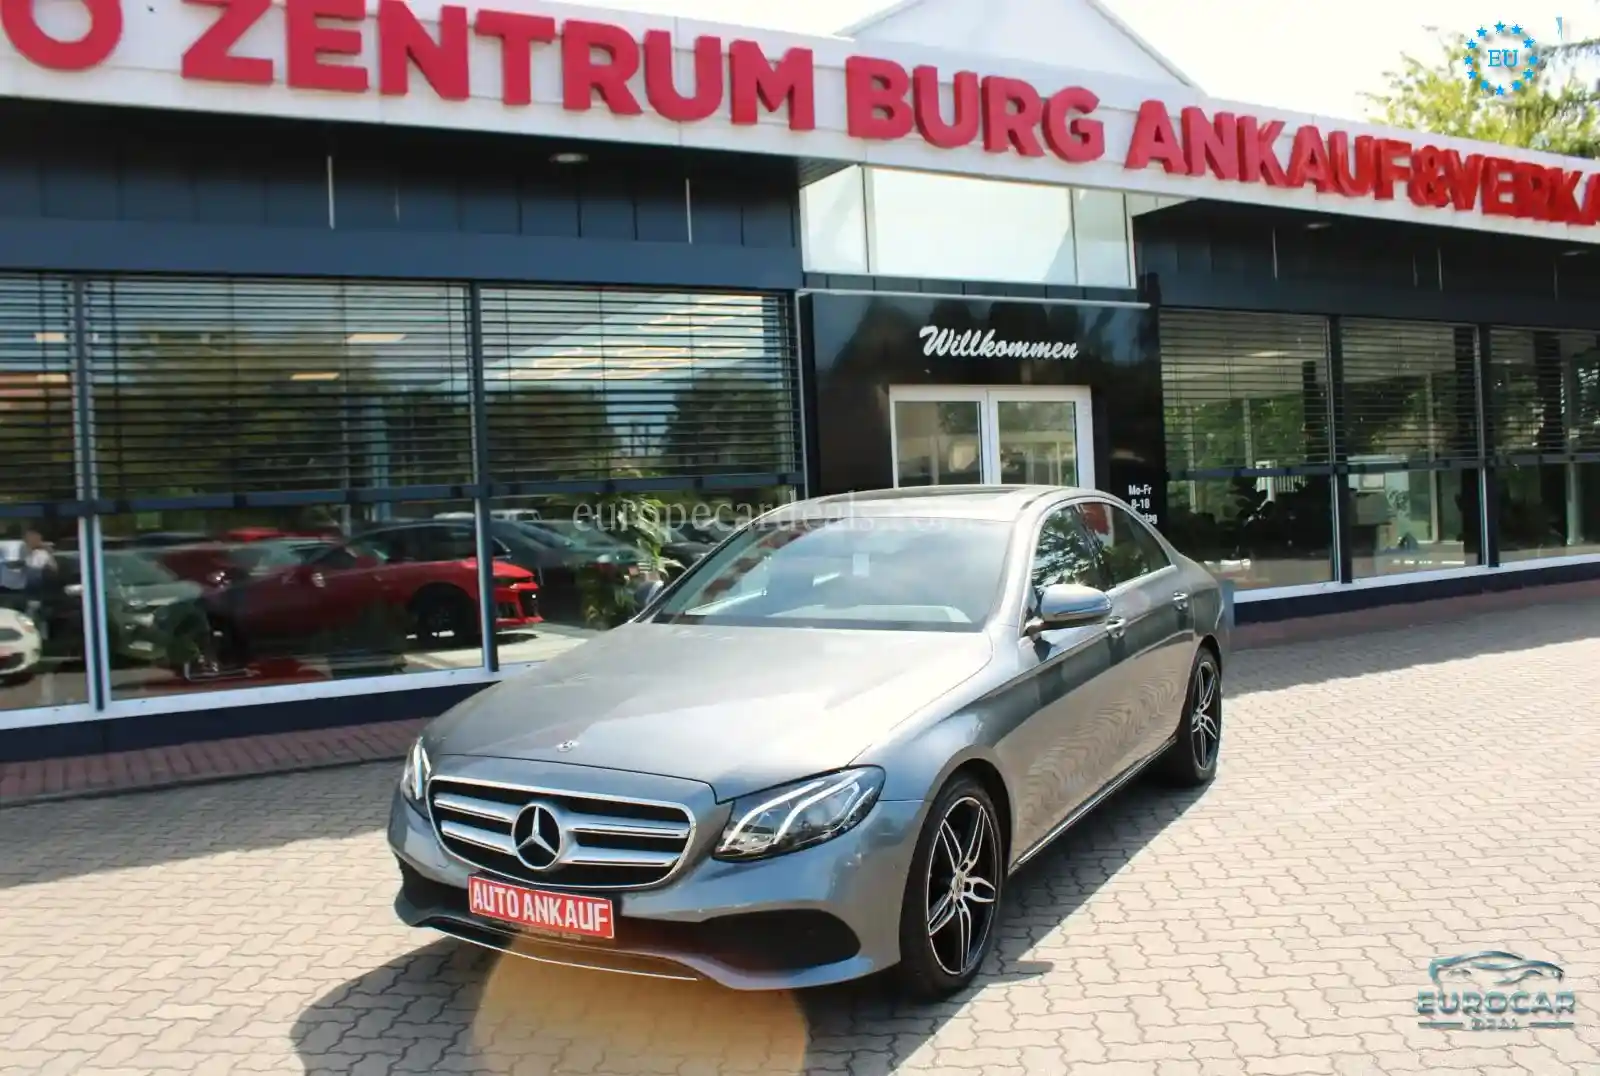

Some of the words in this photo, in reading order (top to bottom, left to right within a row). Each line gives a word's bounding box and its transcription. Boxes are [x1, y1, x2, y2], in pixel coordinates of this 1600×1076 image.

[180, 0, 815, 130] ZENTRUM
[845, 56, 1105, 163] BURG
[919, 325, 1079, 359] Willkommen
[1128, 484, 1152, 496] Mo-Fr
[473, 881, 520, 918] AUTO
[523, 892, 609, 933] ANKAUF
